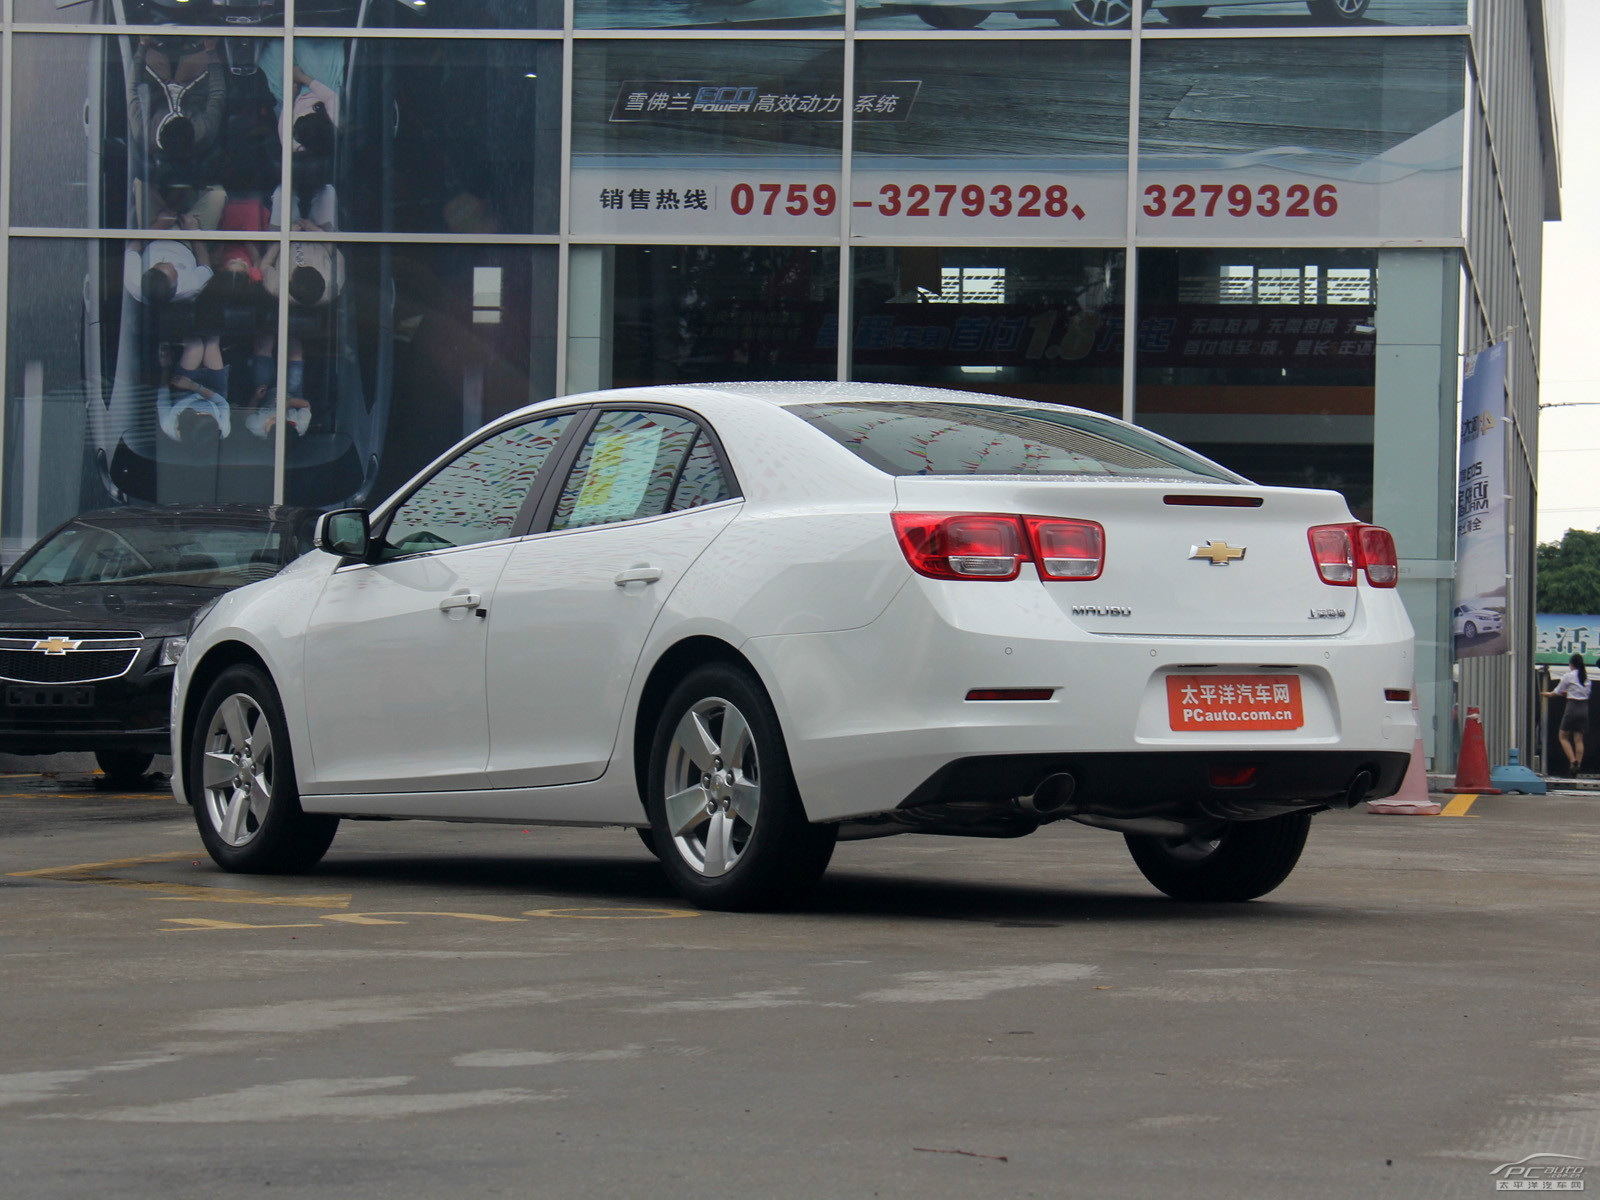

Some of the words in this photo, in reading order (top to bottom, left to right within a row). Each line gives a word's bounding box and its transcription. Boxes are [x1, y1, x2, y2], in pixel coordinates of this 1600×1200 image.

[624, 91, 691, 112] 雪佛兰
[695, 86, 758, 104] ECO
[691, 103, 750, 113] POWER
[599, 188, 708, 211] 销售热线
[1142, 183, 1339, 218] 3279326
[1071, 604, 1132, 617] MALIBU
[1180, 683, 1290, 706] 太平洋汽车网
[1183, 708, 1292, 722] PCauto.com.cn
